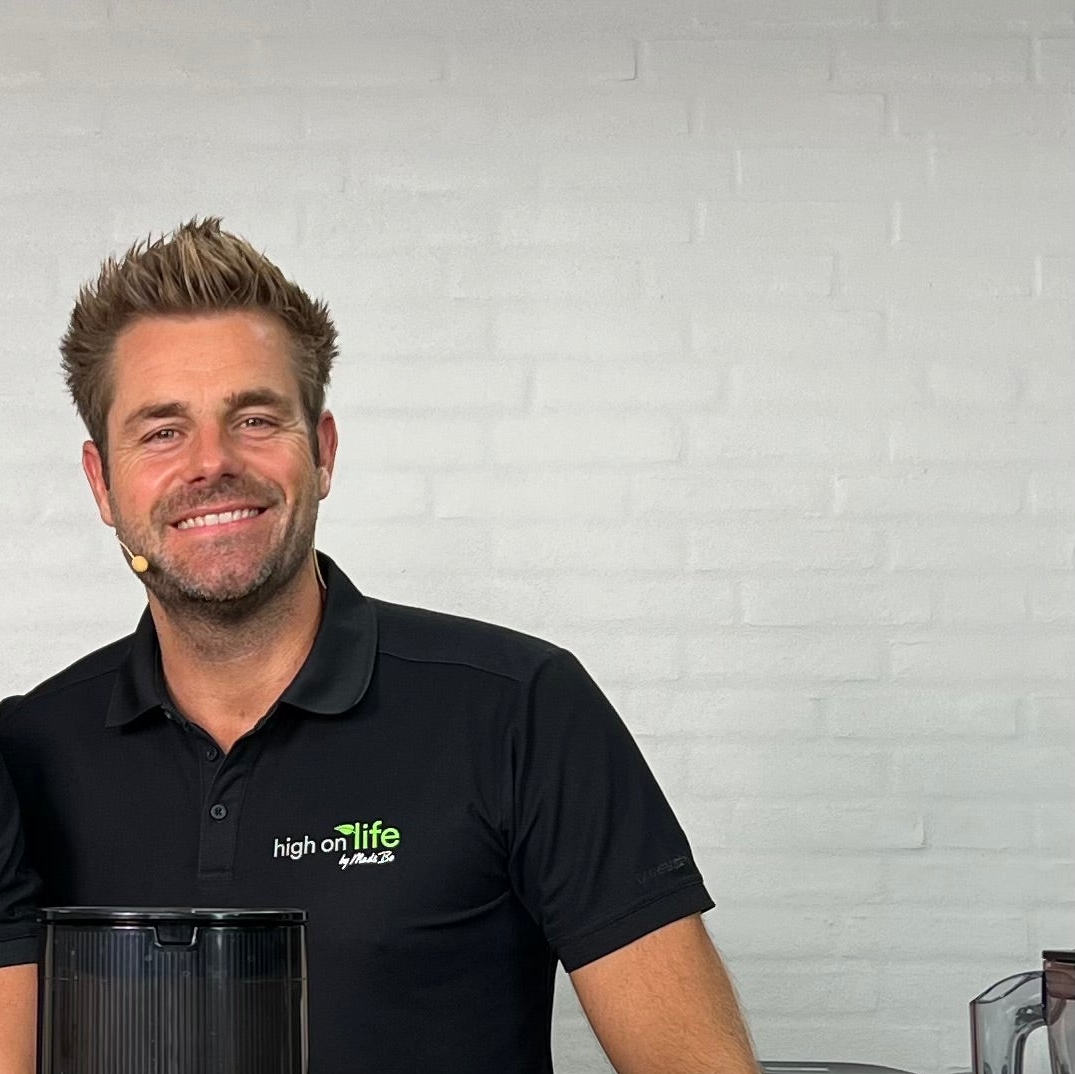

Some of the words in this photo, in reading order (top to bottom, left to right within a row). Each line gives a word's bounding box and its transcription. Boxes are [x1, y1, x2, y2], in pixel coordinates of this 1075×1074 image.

[273, 835, 316, 860] high
[320, 837, 347, 852] on
[354, 820, 400, 850] life
[338, 854, 349, 870] by
